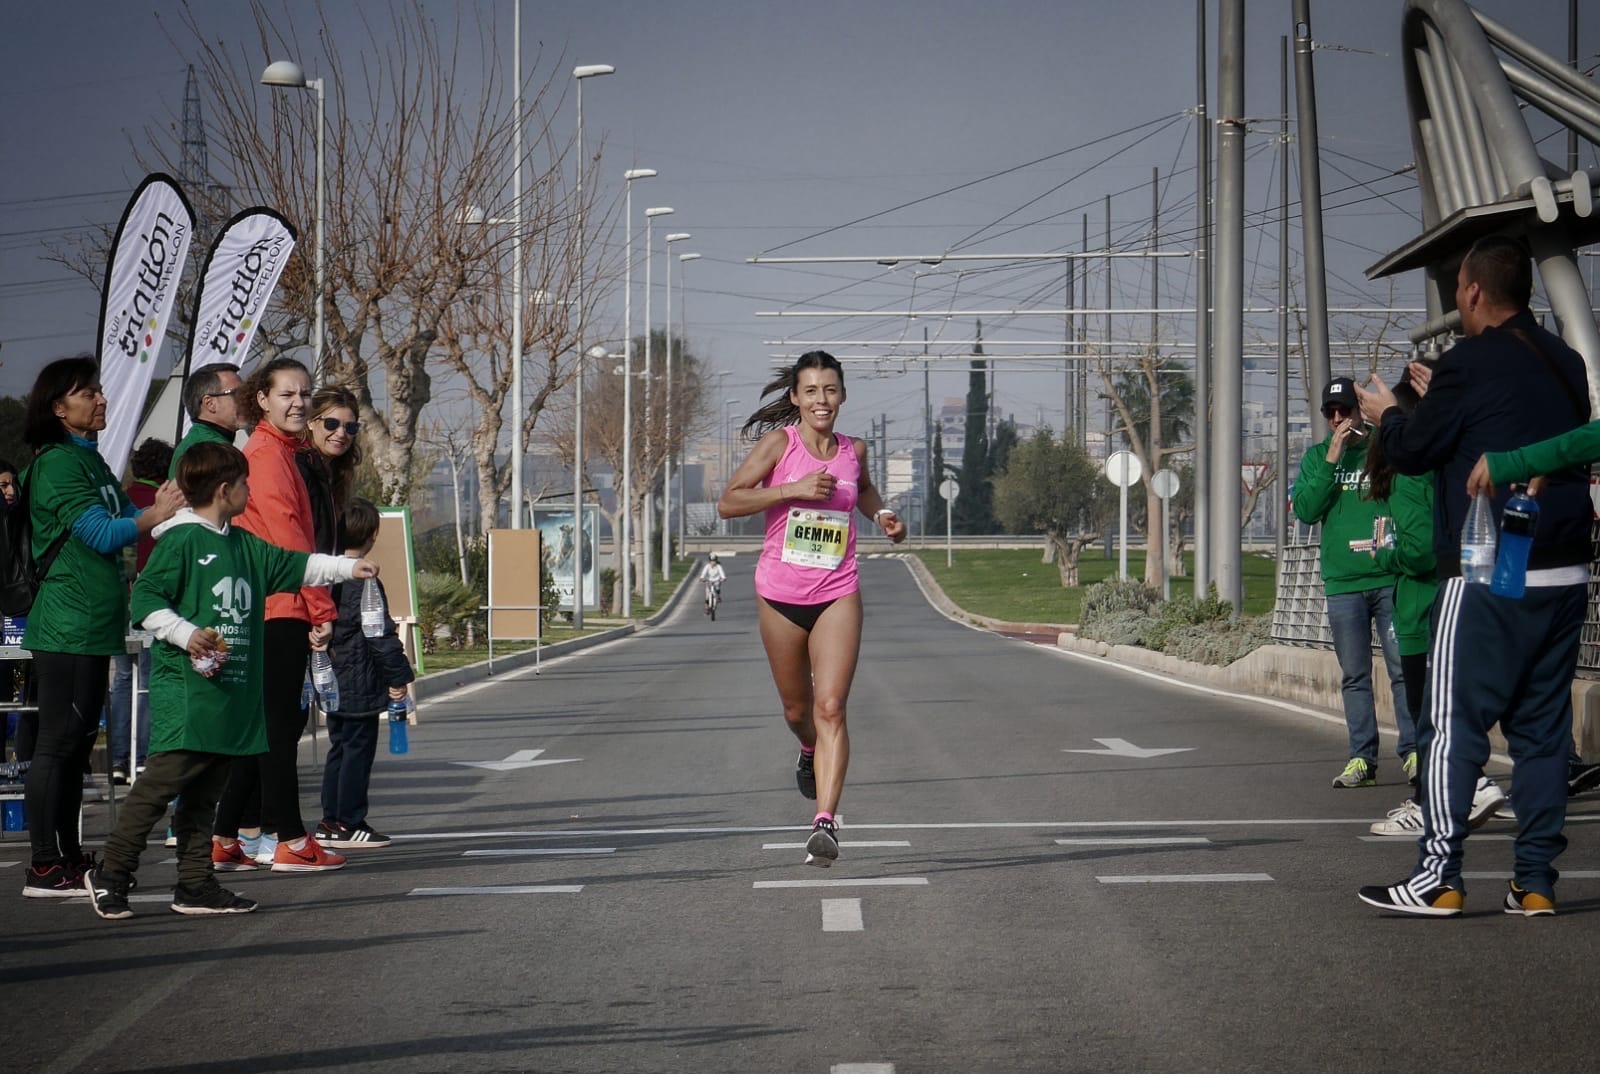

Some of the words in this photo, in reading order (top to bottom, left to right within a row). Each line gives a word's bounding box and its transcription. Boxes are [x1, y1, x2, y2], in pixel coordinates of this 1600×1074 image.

[794, 525, 842, 545] GEMMA
[811, 543, 822, 553] 32
[211, 576, 252, 624] 10
